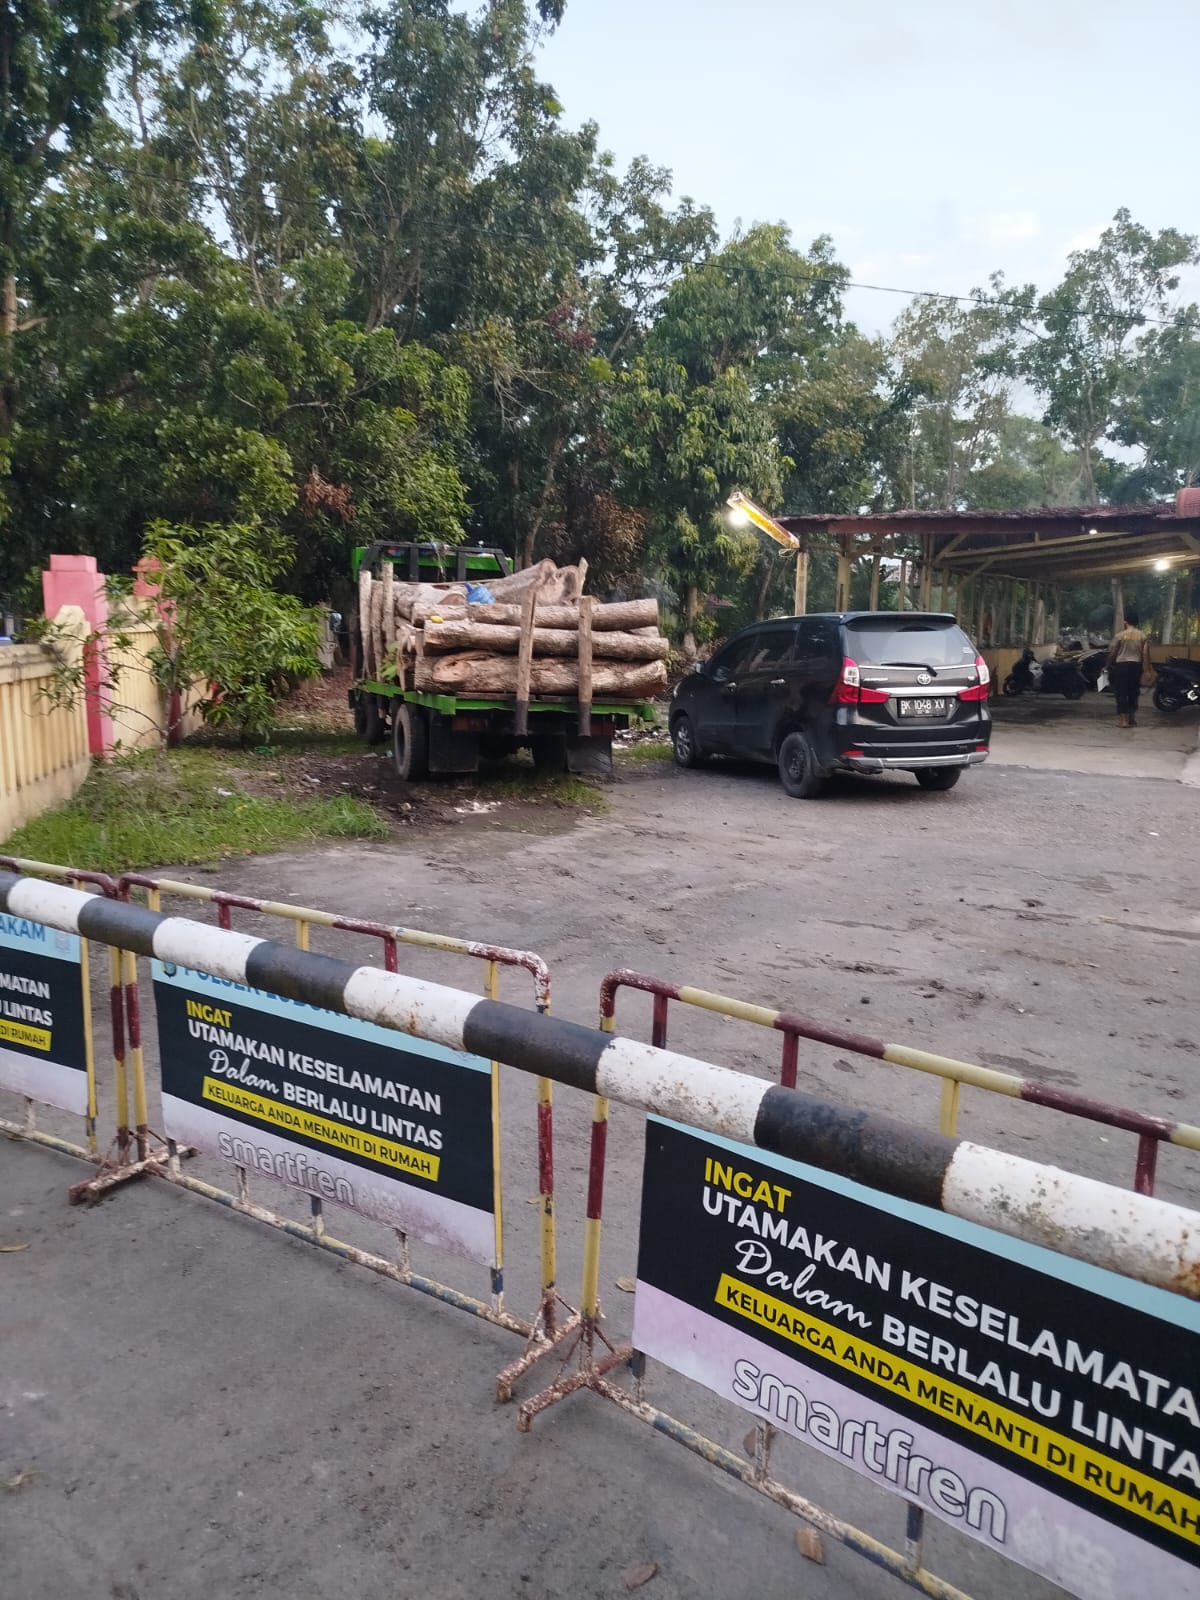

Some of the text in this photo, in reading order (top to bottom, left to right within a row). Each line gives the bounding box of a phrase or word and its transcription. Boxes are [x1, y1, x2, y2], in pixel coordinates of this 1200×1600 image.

[914, 699, 931, 710] 1048
[935, 699, 945, 709] XV
[4, 1000, 53, 1026] LINTAS
[11, 1028, 46, 1046] RUMAH
[186, 1000, 232, 1028] INGAT
[188, 1018, 441, 1115] UTAMAKAN KESELAMATAN
[209, 1050, 443, 1150] Dalam BERLALU LINTAS
[208, 1085, 431, 1174] KELUARGA ANDA MENANTI DI RUMAH
[217, 1131, 355, 1206] smartfren
[704, 1157, 791, 1213] INGAT
[702, 1187, 1200, 1428] UTAMAKAN KESELAMATA
[734, 1239, 1200, 1488] Dalam BERLALU LINTA
[726, 1286, 1200, 1535] KELUARGA ANDA MENANTI DI RUMAH
[732, 1359, 1007, 1543] smartfren
